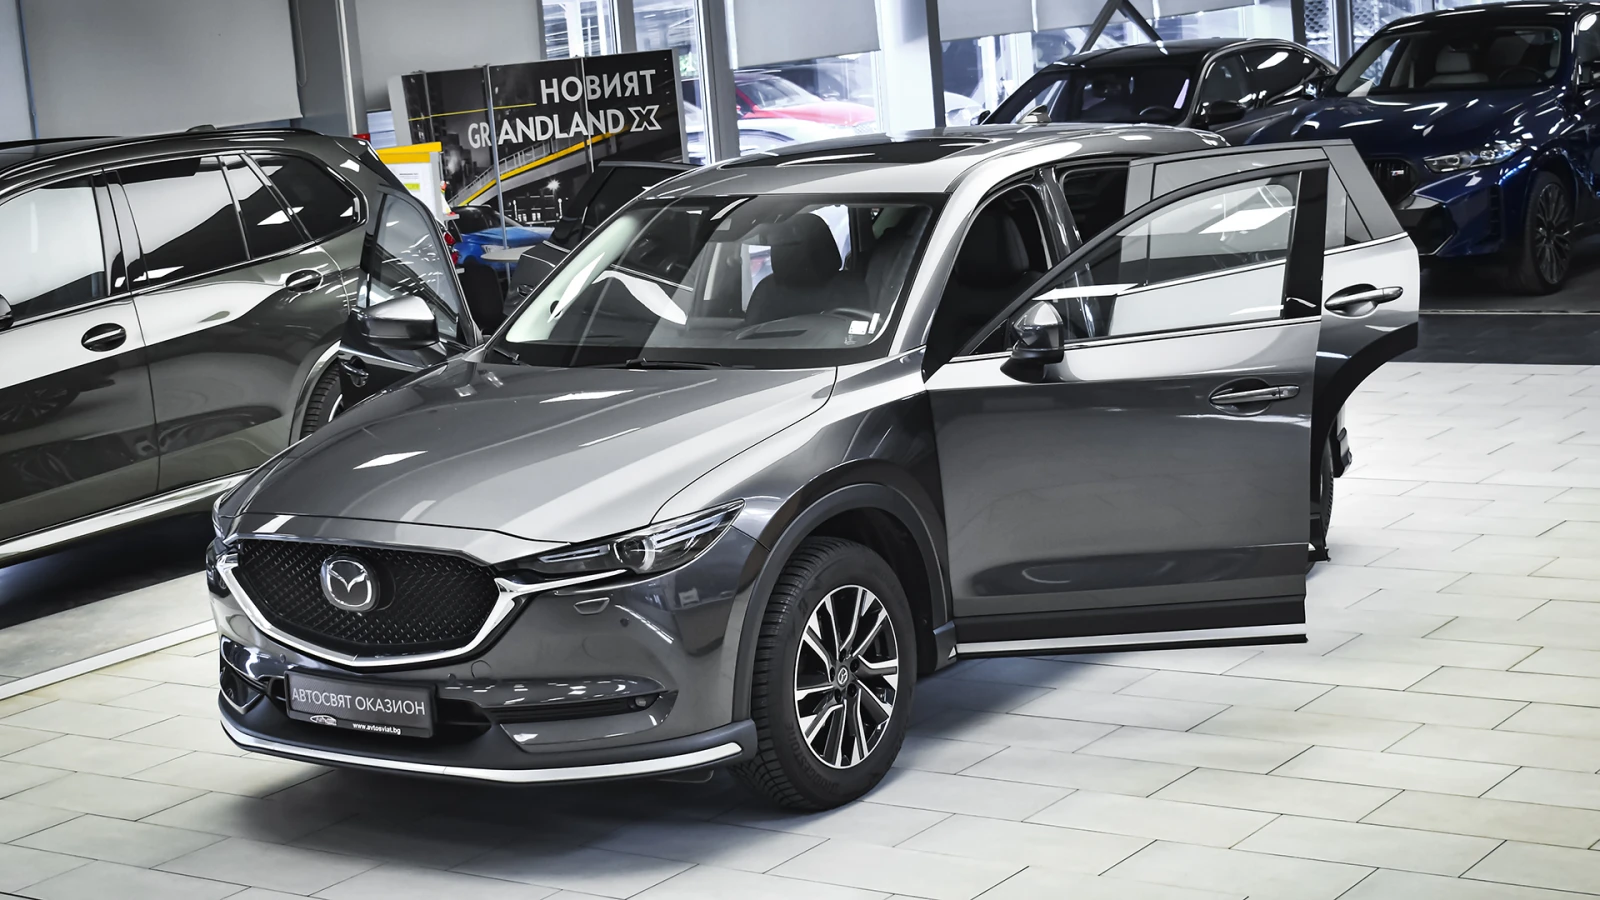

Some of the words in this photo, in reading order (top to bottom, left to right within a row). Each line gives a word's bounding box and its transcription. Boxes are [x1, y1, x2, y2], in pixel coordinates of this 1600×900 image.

[540, 69, 656, 104] НОВИЯТ
[468, 109, 625, 149] GRANDLAND
[628, 105, 662, 132] X
[292, 688, 352, 708] АВТОСВЯТ
[355, 696, 425, 715] ОКАЗИОН
[352, 723, 401, 735] www.avtosviat.bg
